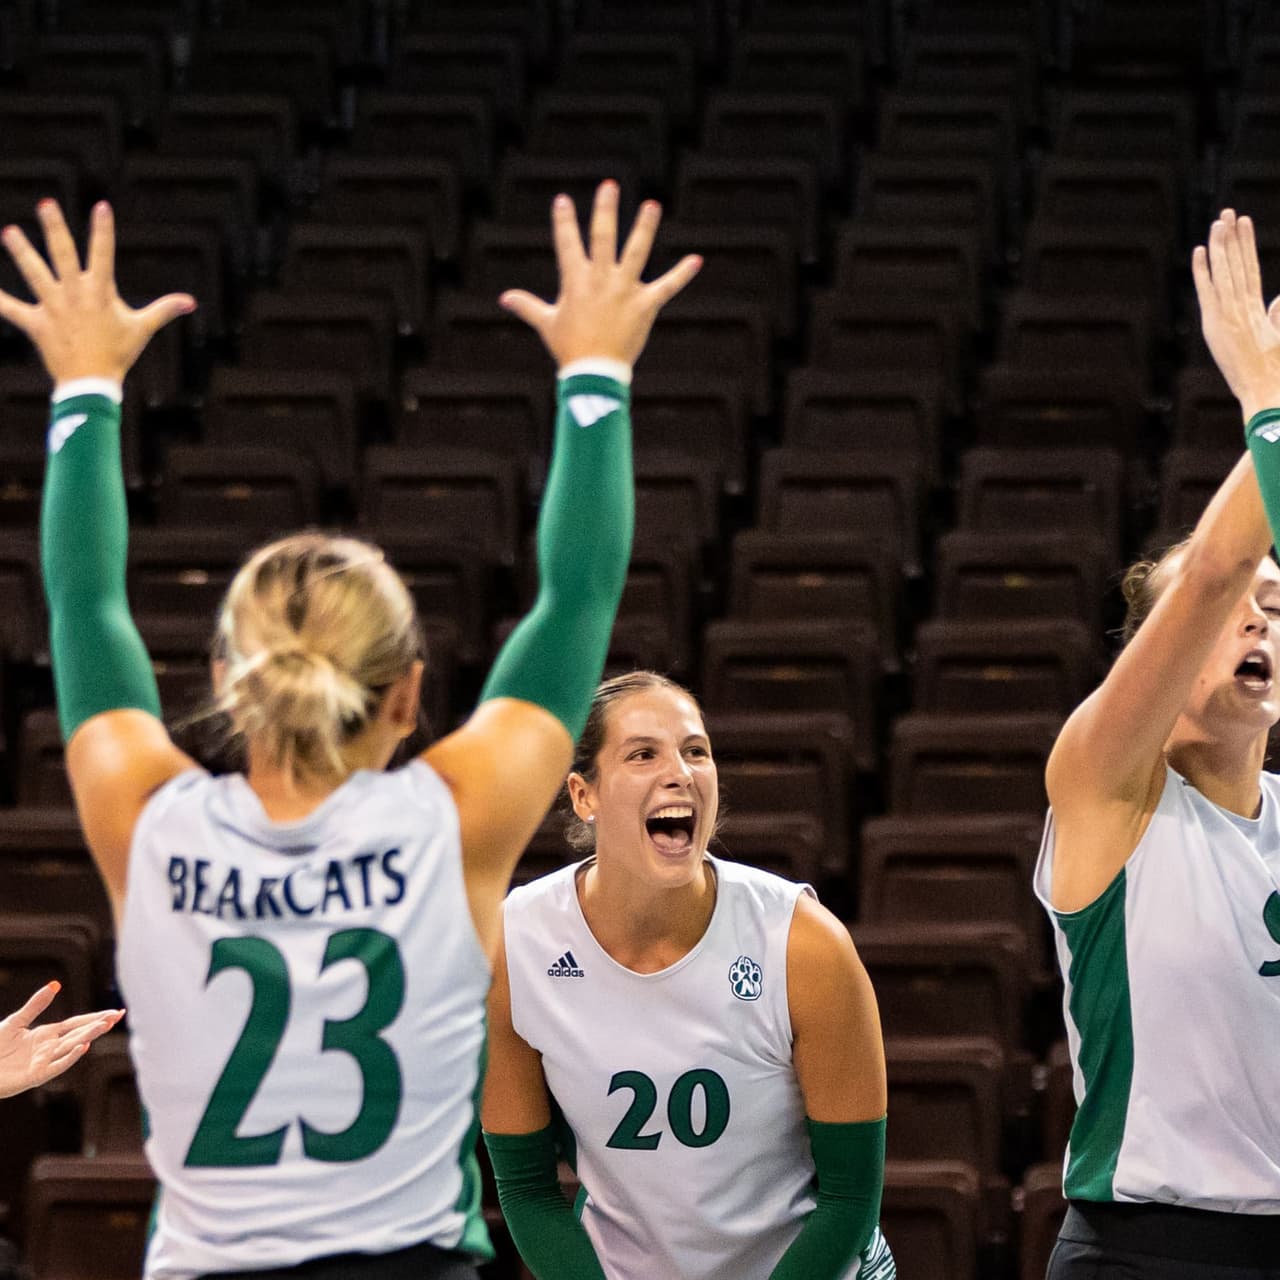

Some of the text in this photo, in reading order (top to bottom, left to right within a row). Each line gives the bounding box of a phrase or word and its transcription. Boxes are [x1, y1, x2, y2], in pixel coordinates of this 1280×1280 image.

[167, 847, 407, 921] BEARCATS
[547, 966, 585, 978] adidas
[183, 926, 407, 1168] 23
[605, 1067, 731, 1151] 20
